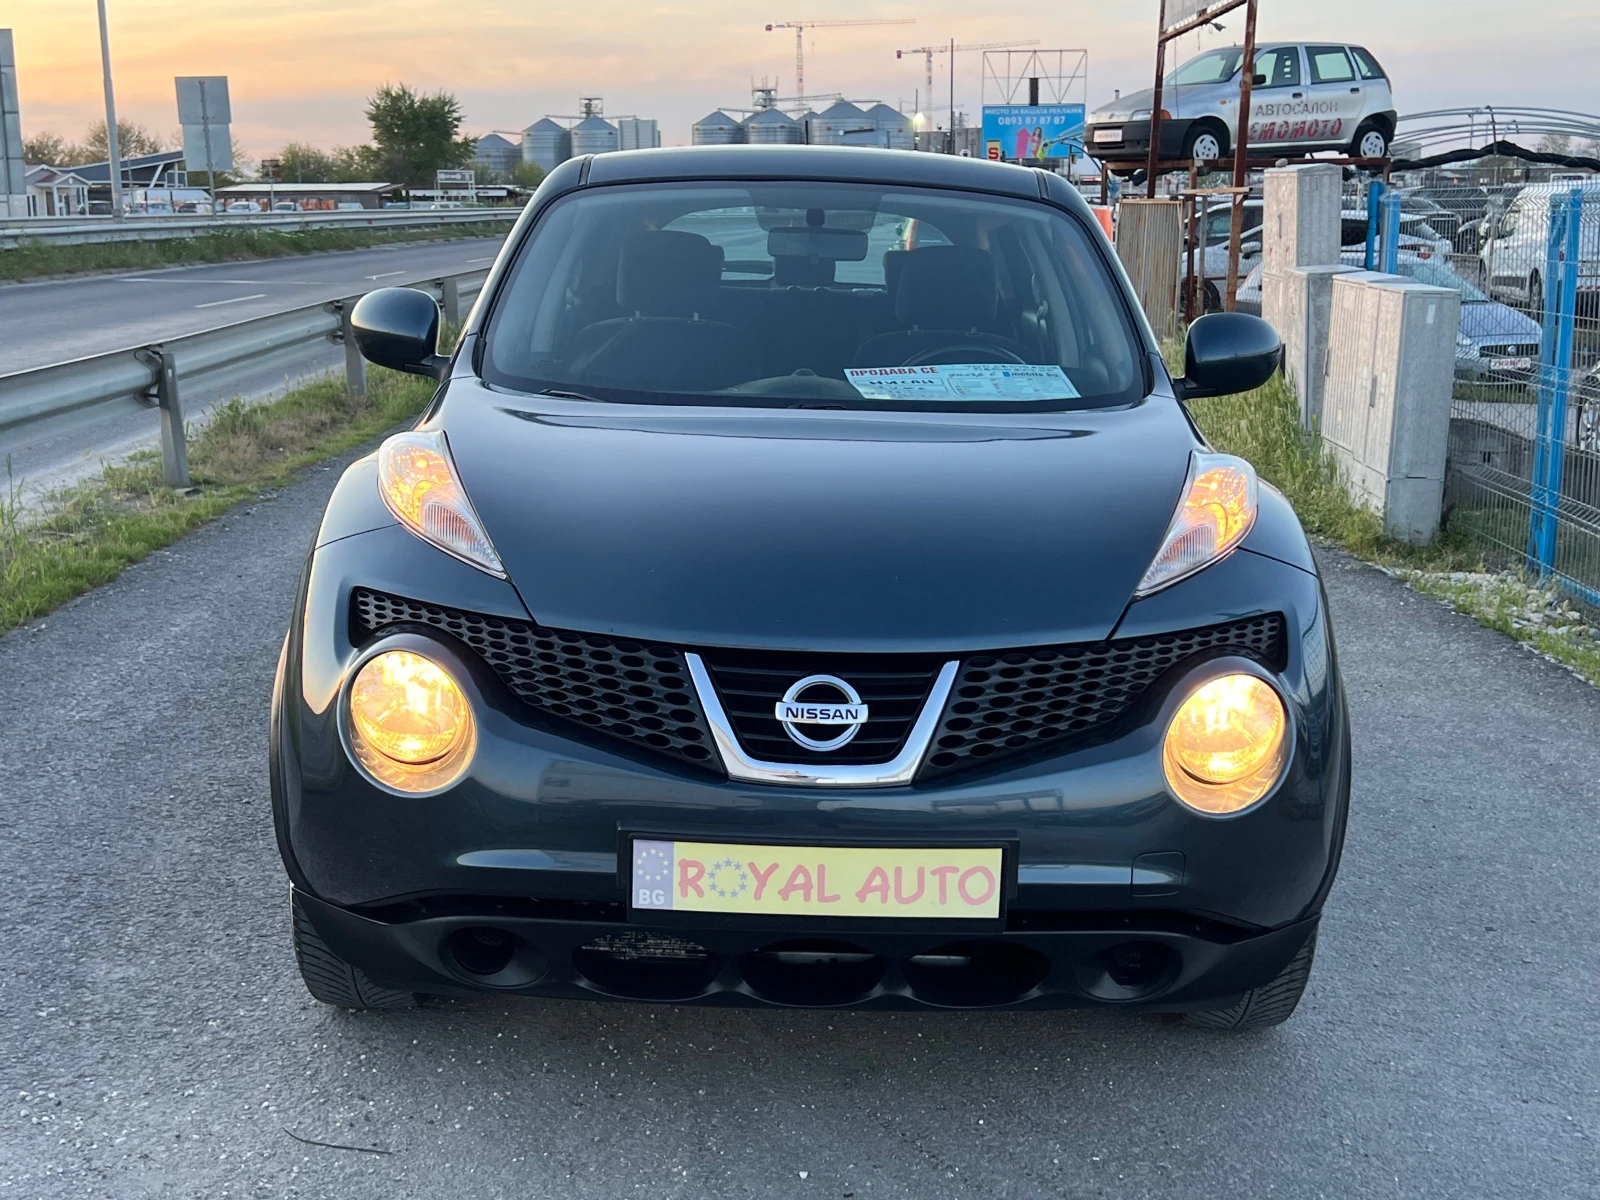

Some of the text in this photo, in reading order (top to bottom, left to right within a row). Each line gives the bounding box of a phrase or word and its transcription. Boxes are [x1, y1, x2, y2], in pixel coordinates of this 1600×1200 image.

[1255, 101, 1338, 116] АВТОСАЛОН
[997, 116, 1066, 125] 0893 87 87 87
[849, 366, 939, 377] ПРОДАВА СЕ
[785, 706, 859, 720] NISSAN
[855, 864, 995, 906] AUTO
[638, 888, 665, 905] BG
